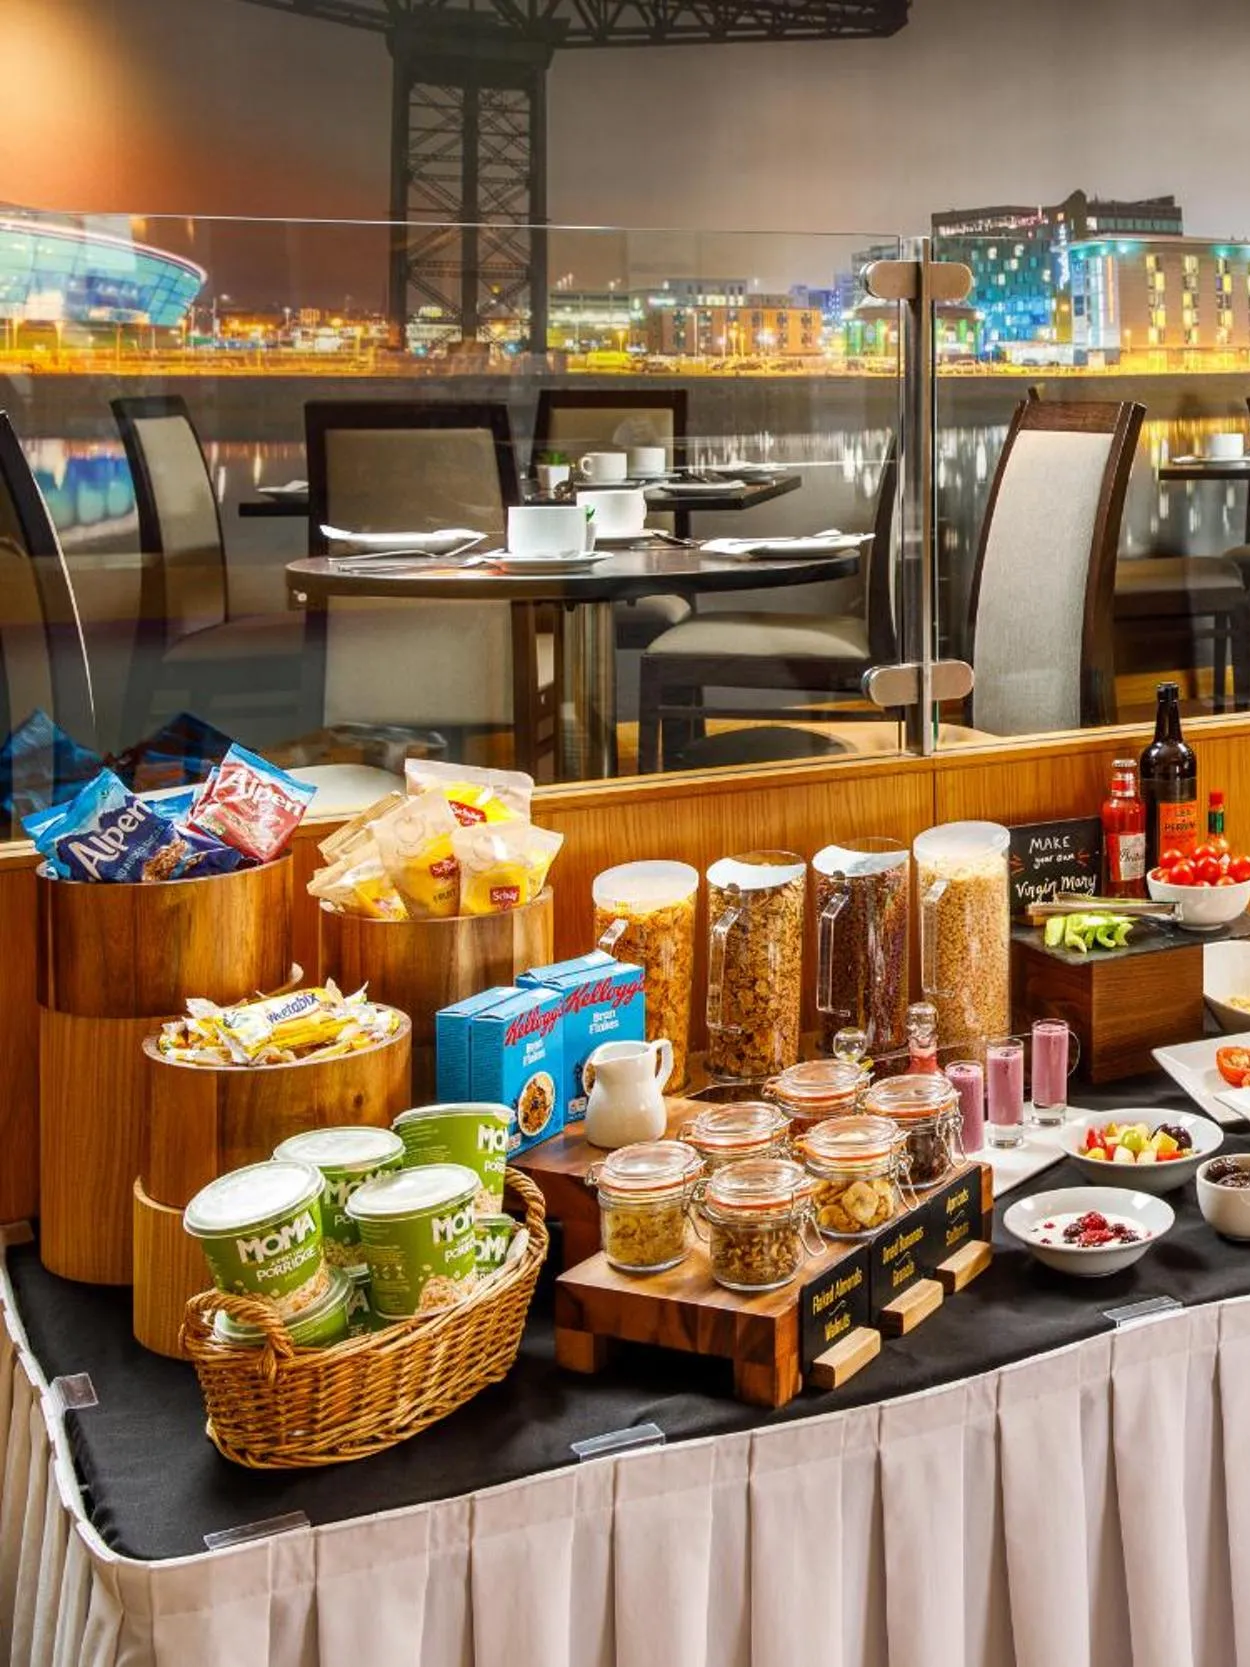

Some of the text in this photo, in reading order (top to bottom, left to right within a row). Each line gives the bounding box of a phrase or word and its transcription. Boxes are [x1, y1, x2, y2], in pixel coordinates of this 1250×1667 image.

[212, 768, 304, 817] Alpen
[67, 800, 152, 881] Alpen
[1028, 835, 1071, 855] MAKE
[1033, 853, 1075, 870] your own
[1015, 873, 1097, 904] Virgin Mary
[266, 993, 320, 1023] Weetabix
[565, 974, 646, 1013] Kellogg's
[505, 998, 565, 1046] Kellogg's
[593, 1009, 617, 1022] Bran
[236, 1210, 316, 1264] MOMA
